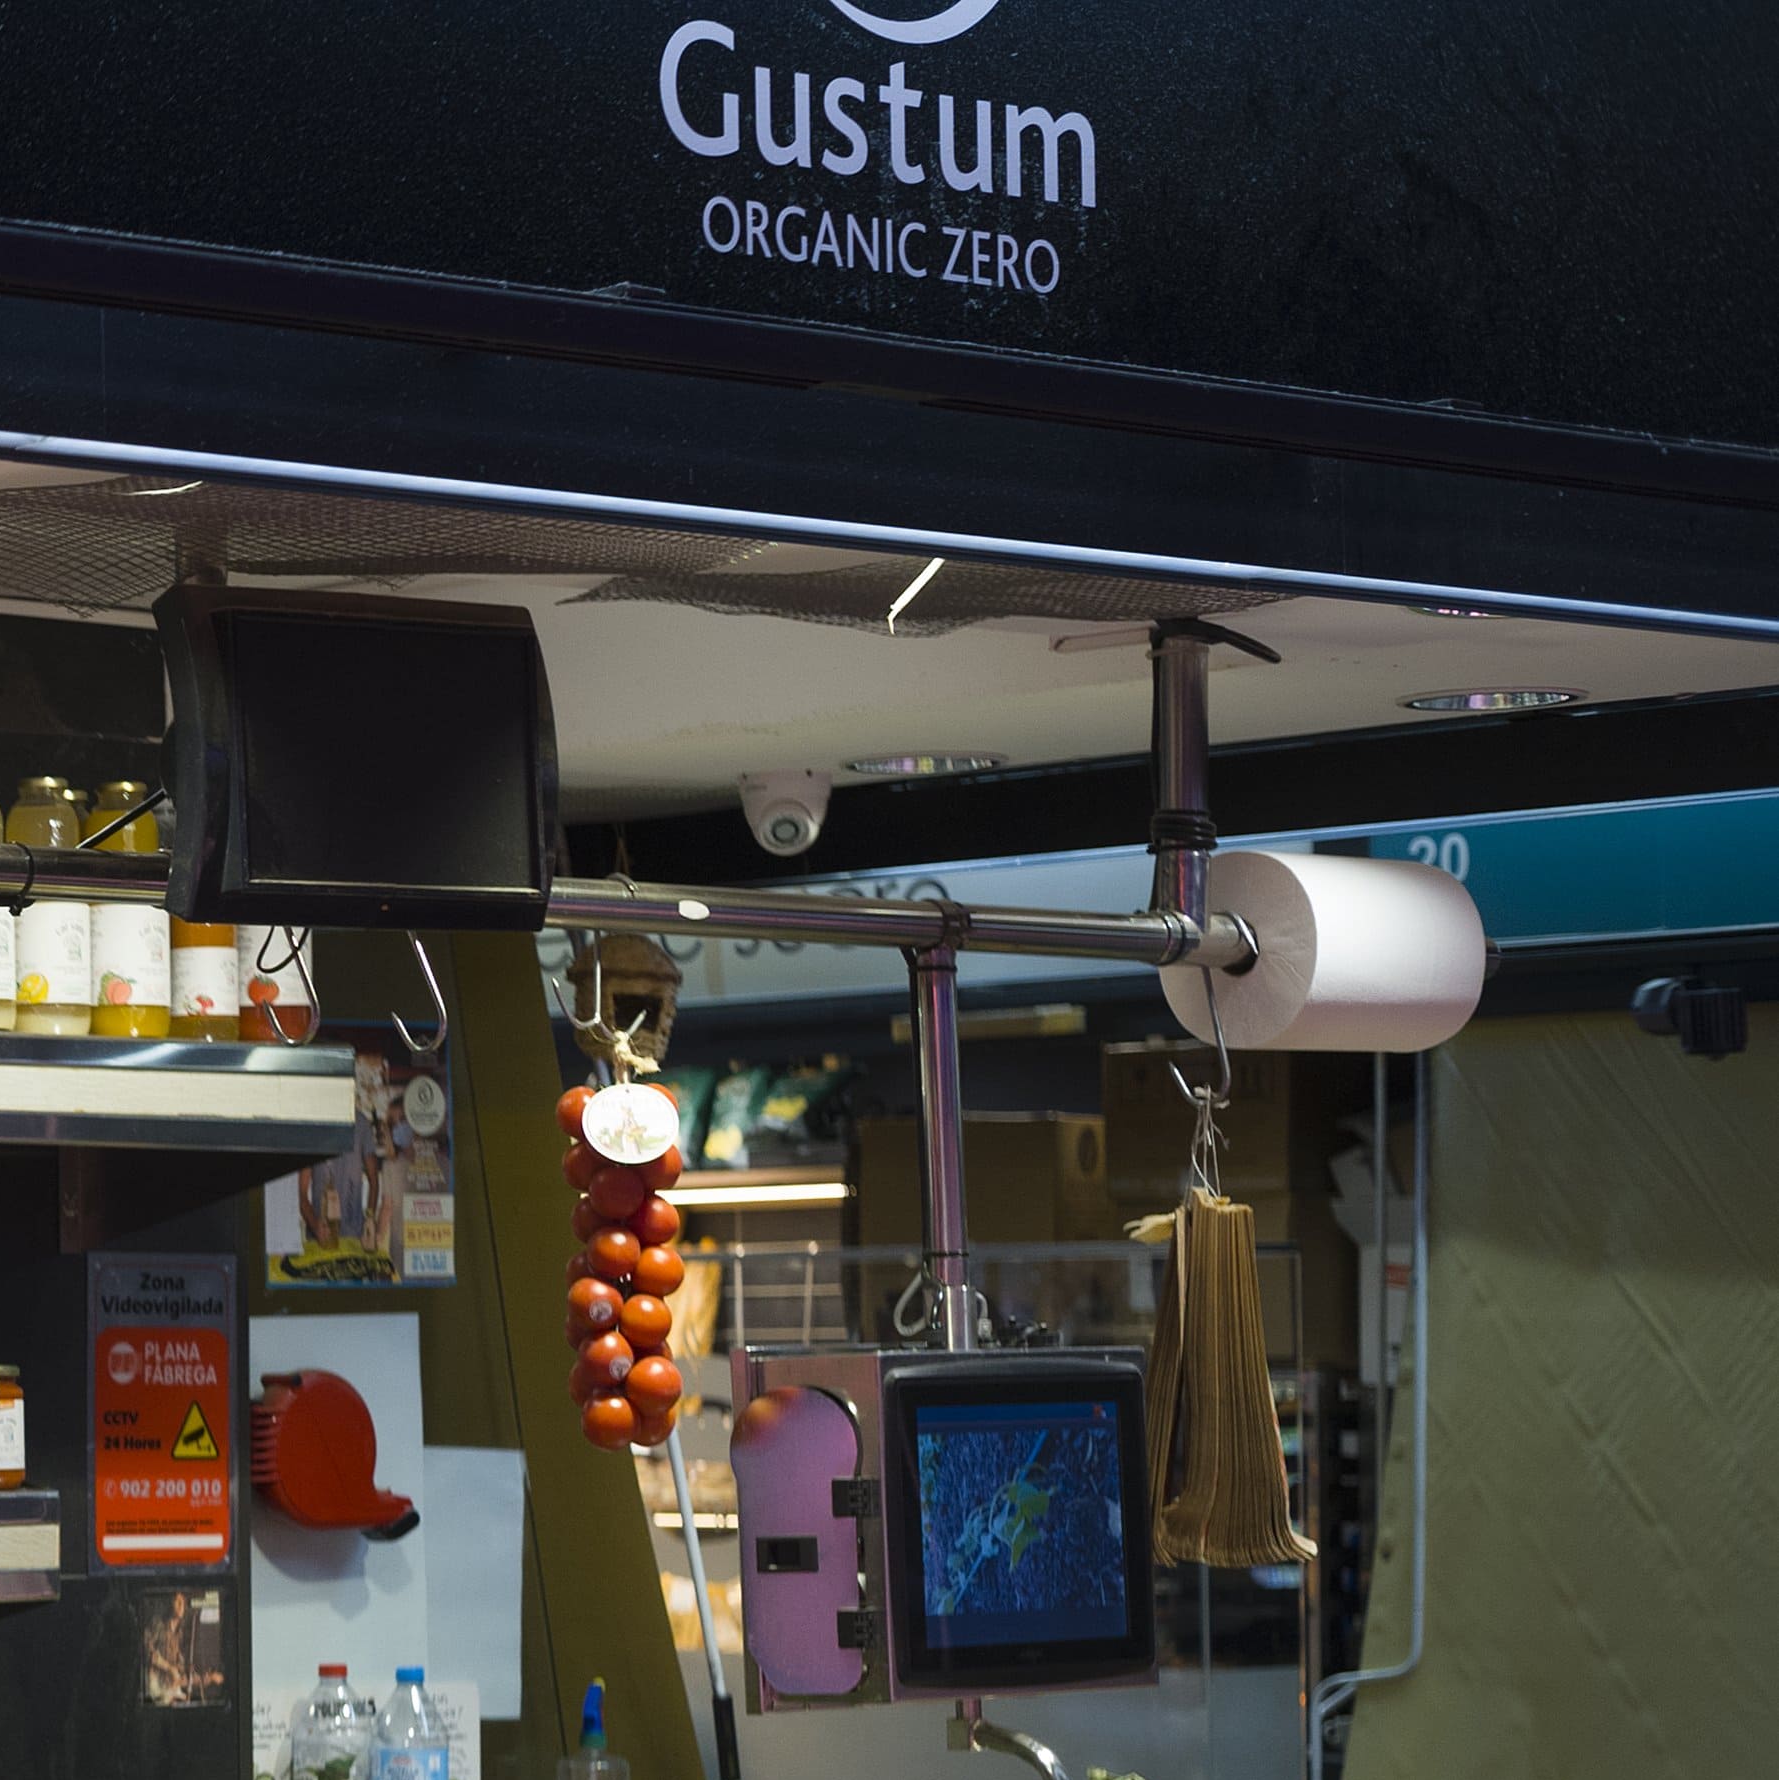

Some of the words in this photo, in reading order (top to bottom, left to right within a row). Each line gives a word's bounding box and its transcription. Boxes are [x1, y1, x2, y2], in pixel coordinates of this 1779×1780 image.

[660, 20, 1096, 208] Gustum
[703, 196, 927, 278] ORGANIC
[941, 226, 1059, 294] ZERO
[140, 1272, 185, 1291] Zona
[101, 1296, 224, 1320] Videovigilada
[144, 1340, 201, 1362] PLANA
[104, 1411, 139, 1425] CCTV
[104, 1436, 120, 1449] 24
[120, 1478, 151, 1498] 902
[155, 1478, 186, 1498] 200
[192, 1478, 222, 1497] 010
